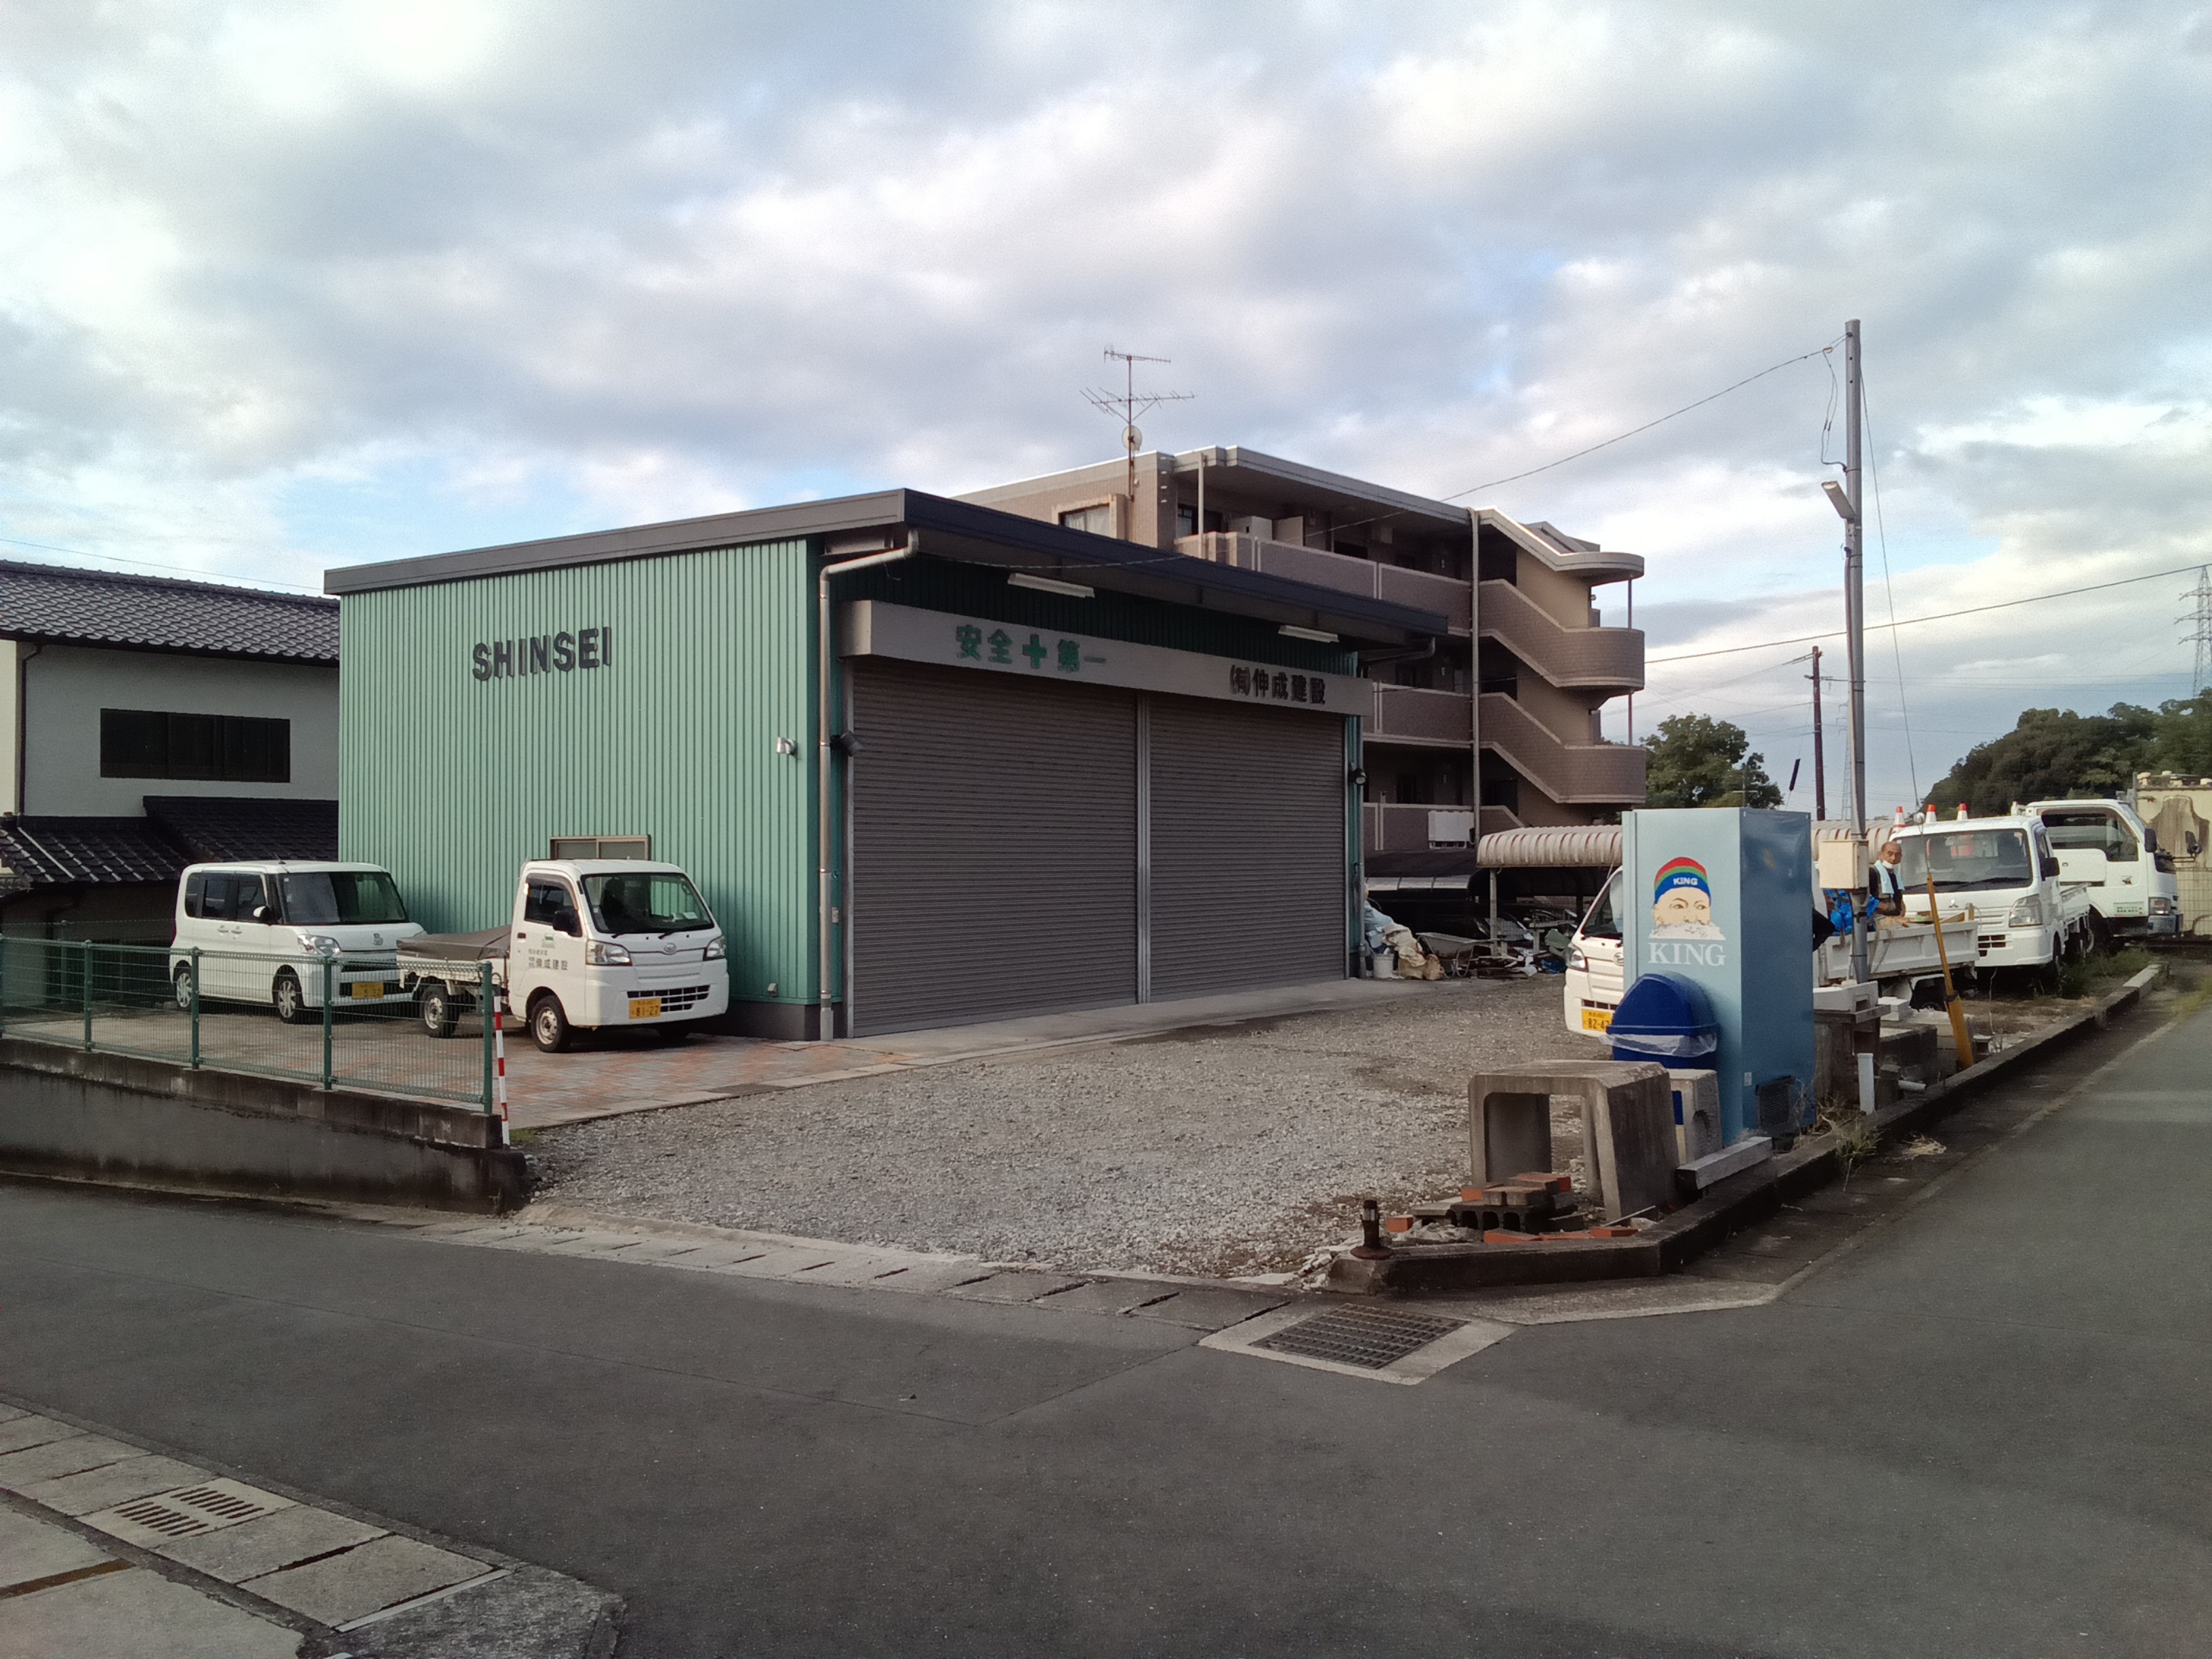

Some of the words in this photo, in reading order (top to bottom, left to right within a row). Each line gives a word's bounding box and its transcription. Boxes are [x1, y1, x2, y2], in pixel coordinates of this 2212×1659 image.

[472, 626, 612, 682] SHINSEI
[1673, 877, 1698, 886] KING
[1647, 942, 1727, 966] KING
